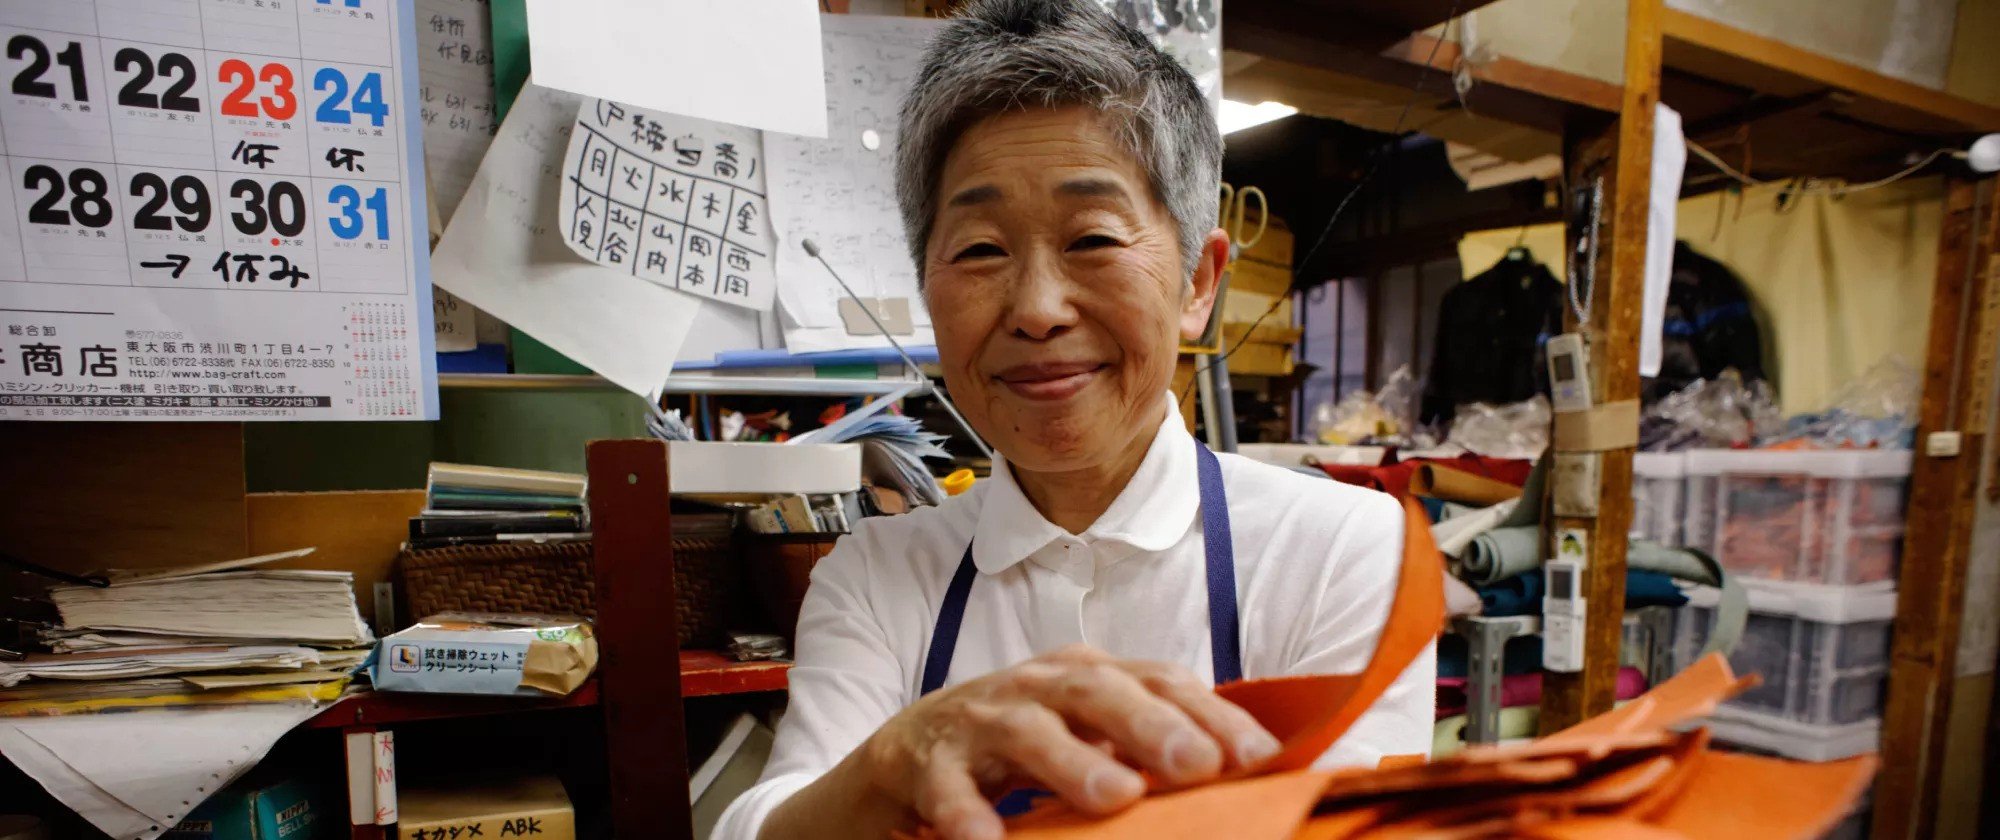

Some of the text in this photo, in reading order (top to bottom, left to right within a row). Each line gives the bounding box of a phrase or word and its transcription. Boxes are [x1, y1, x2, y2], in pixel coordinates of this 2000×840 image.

[7, 34, 89, 102] 21
[114, 47, 201, 113] 22
[218, 59, 298, 121] 23
[314, 67, 389, 127] 24
[231, 140, 280, 170] 休
[24, 164, 113, 228] 28
[130, 172, 211, 233] 29
[230, 178, 306, 237] 30
[328, 184, 390, 241] 31
[591, 148, 758, 236] 月 火 水 木 金
[605, 208, 637, 264] 北谷
[647, 223, 674, 274] 山内
[683, 234, 711, 286] 岡本
[212, 251, 310, 288] 休み
[724, 247, 751, 297] 西岡
[0, 342, 118, 377] 商店
[129, 369, 286, 381] http://www.bag-craft.com
[425, 648, 510, 661] 拭き掃除ウェット
[426, 661, 498, 675] クリーンシート
[500, 817, 544, 837] ABK
